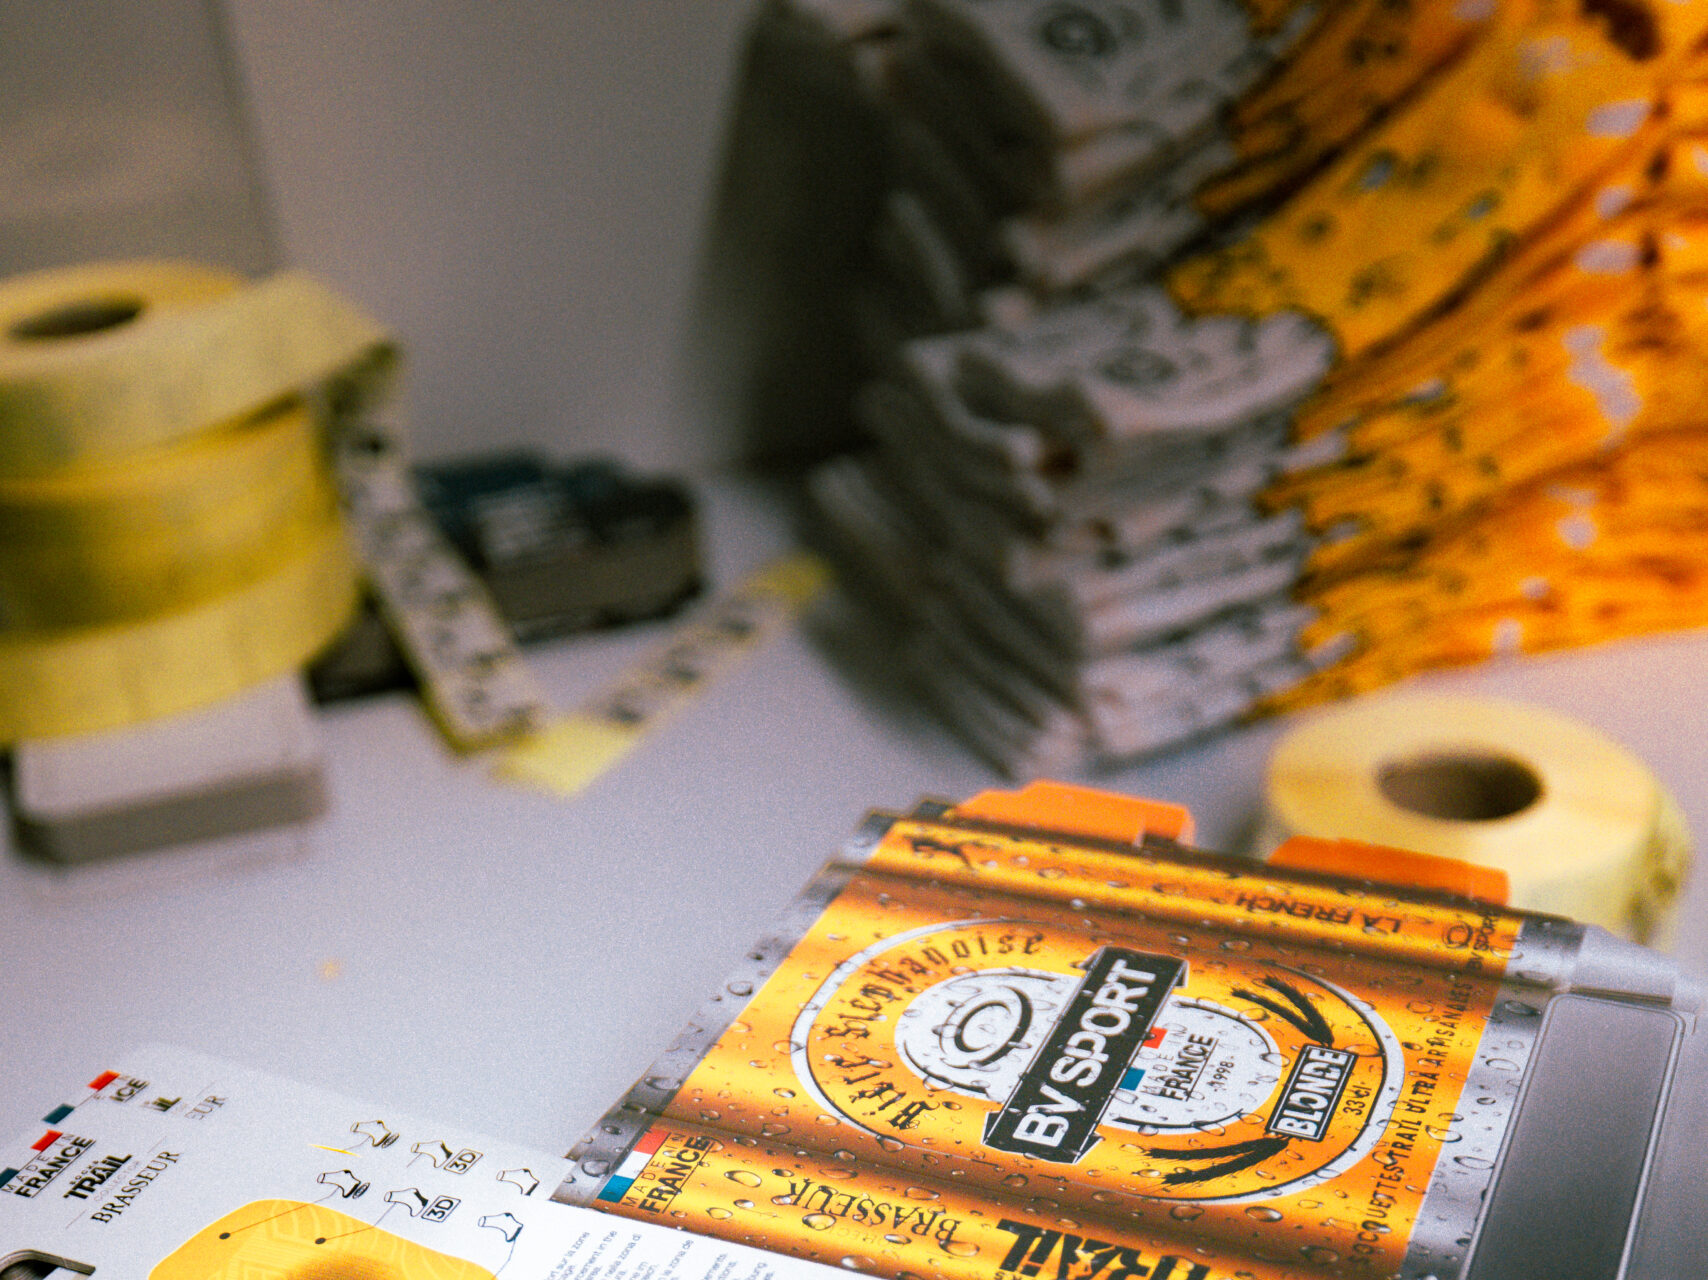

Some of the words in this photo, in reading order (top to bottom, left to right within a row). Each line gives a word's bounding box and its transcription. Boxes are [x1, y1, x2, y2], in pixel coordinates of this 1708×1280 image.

[1235, 892, 1353, 925] FRENCH
[1012, 1081, 1087, 1148] BV
[1050, 958, 1156, 1088] SPORT
[1159, 1033, 1214, 1101] FRANCE
[1276, 1047, 1349, 1138] BLONDE
[15, 1136, 93, 1198] FRANCE
[90, 1150, 183, 1224] BRASSEUR
[450, 1151, 477, 1172] 3D
[638, 1135, 711, 1216] FRANCE
[428, 1198, 455, 1220] 3D
[787, 1178, 963, 1242] BRASSEUR
